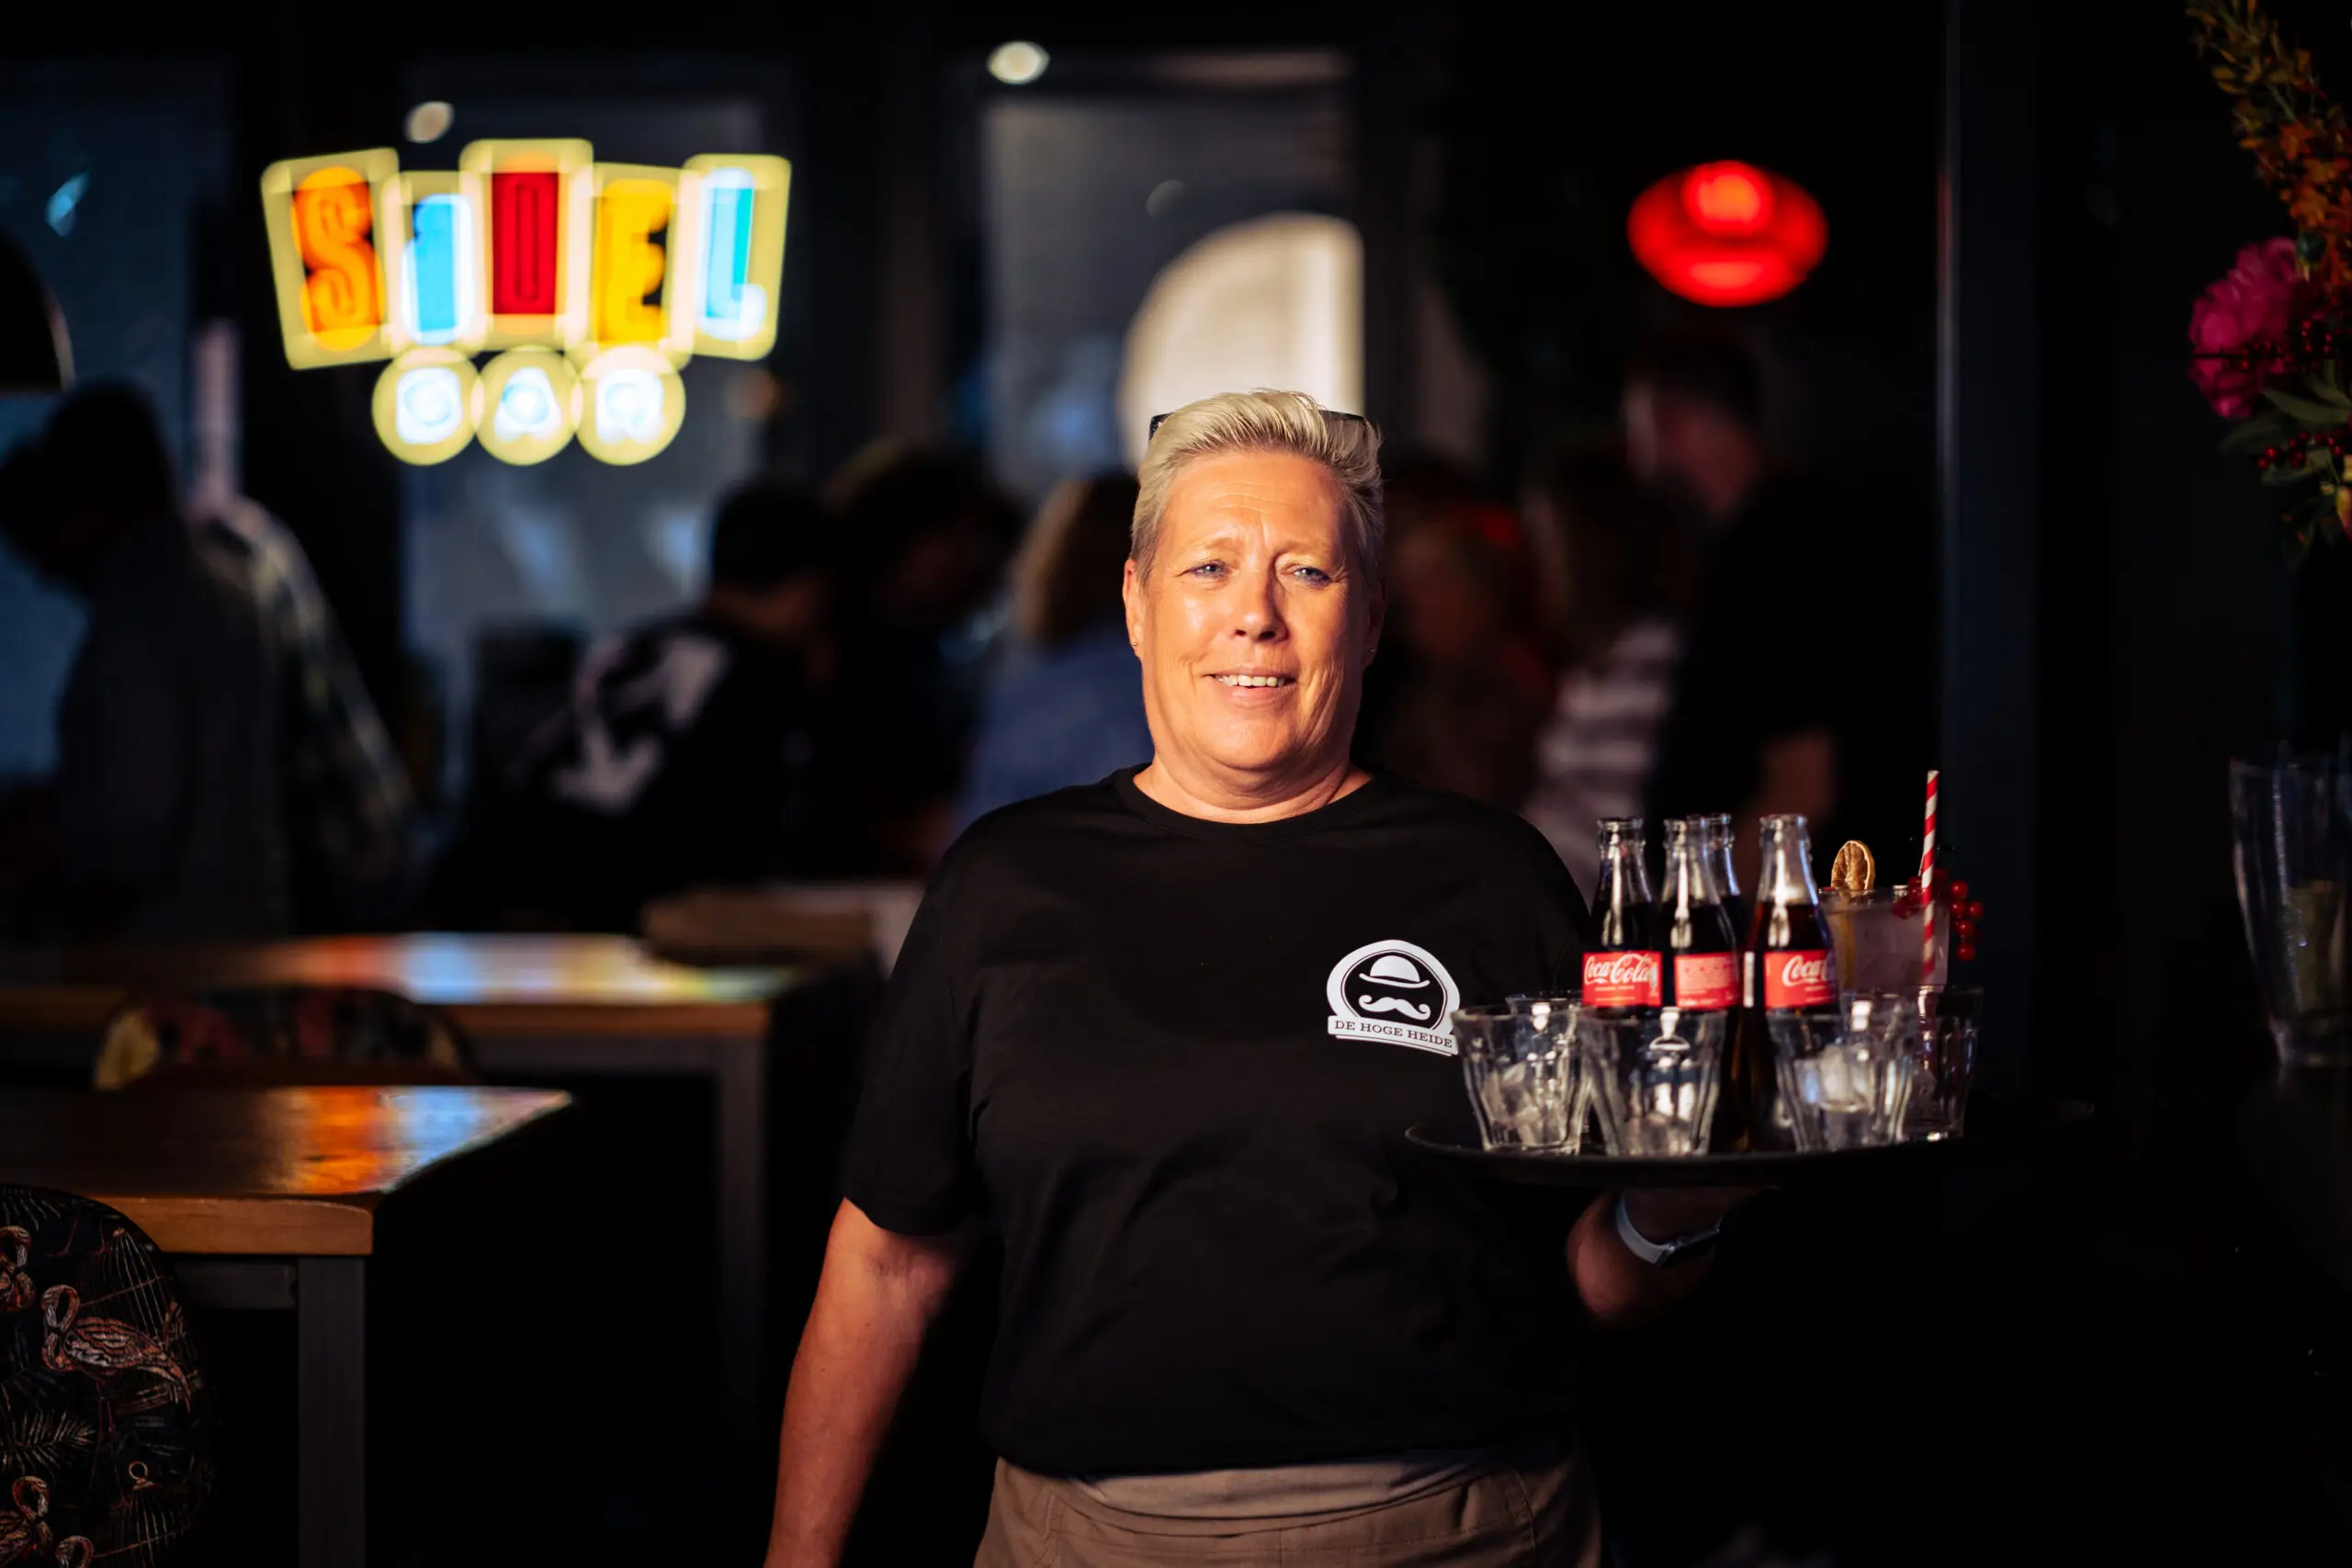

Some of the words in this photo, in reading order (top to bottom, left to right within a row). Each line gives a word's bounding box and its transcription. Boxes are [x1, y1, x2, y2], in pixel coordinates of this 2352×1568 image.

[1335, 1021, 1355, 1031] DE
[1360, 1022, 1403, 1036] HOGE
[1408, 1031, 1453, 1048] HEIDE
